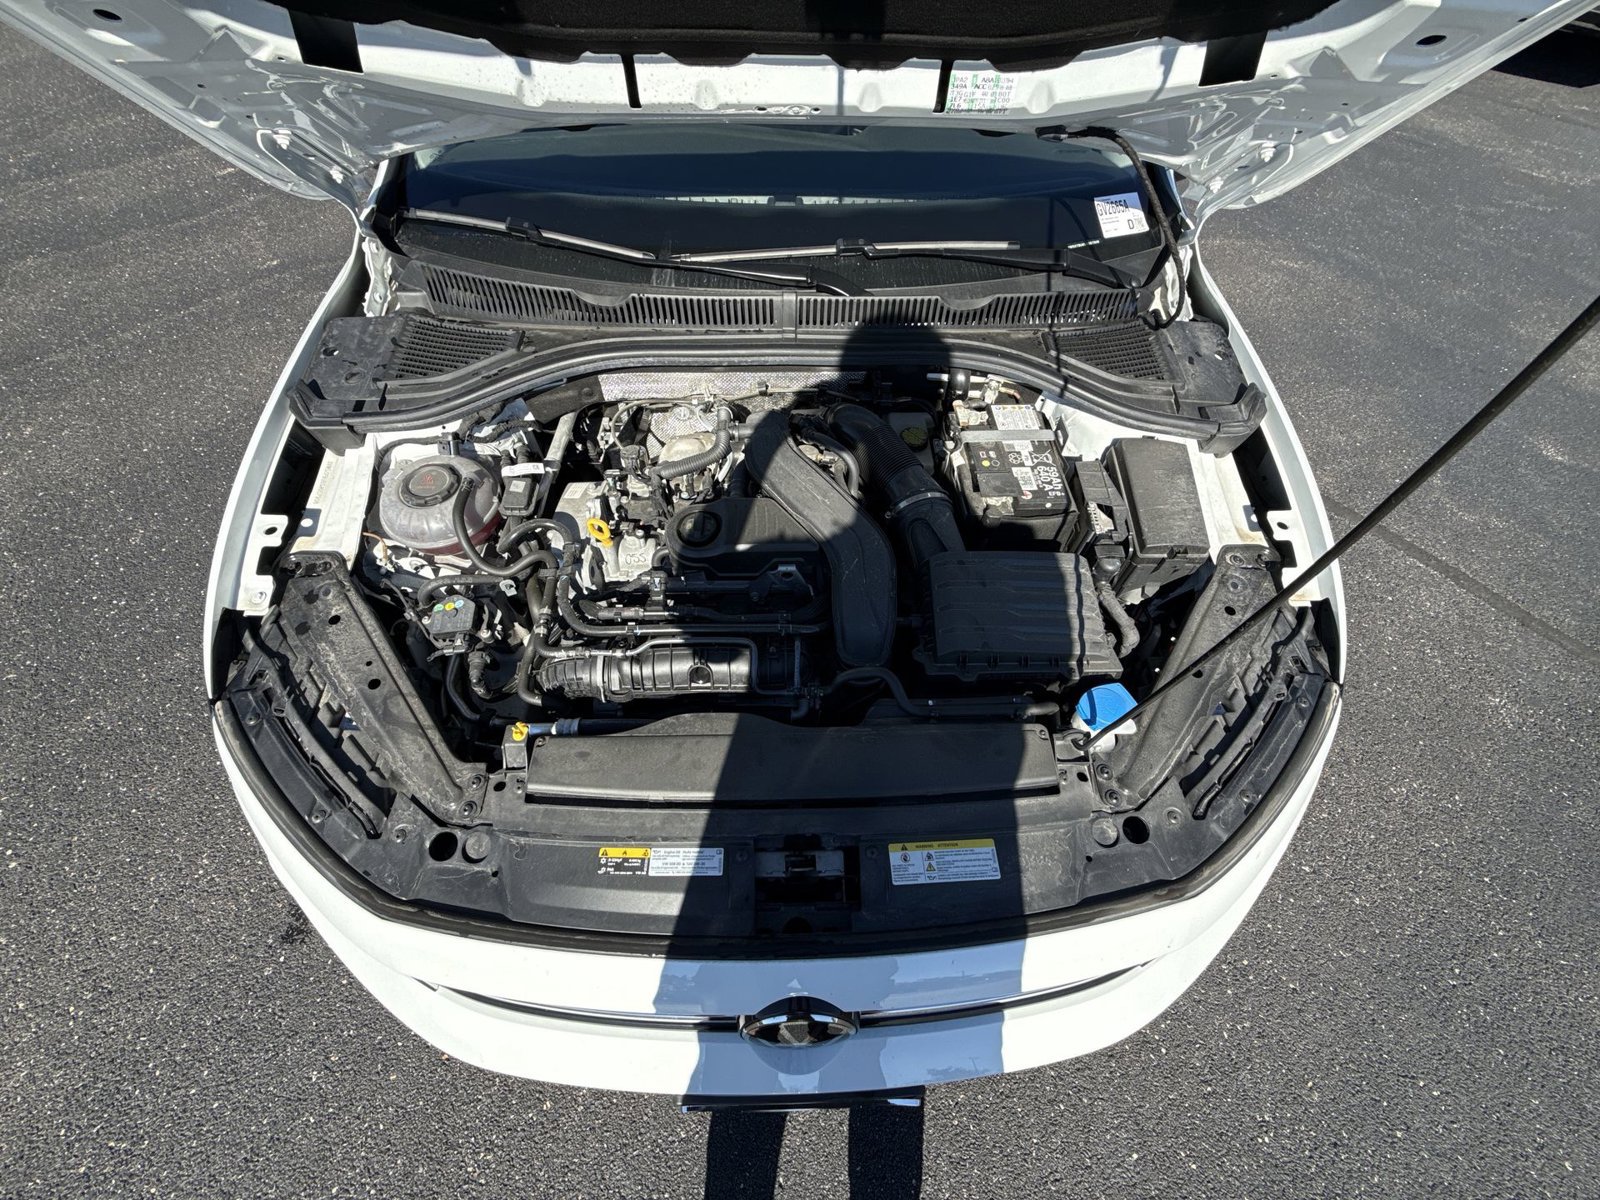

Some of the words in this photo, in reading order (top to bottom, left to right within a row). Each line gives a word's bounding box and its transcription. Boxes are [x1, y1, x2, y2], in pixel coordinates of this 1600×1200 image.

[1036, 465, 1051, 483] 640
[1046, 465, 1063, 490] 59Ah
[1043, 483, 1055, 491] A
